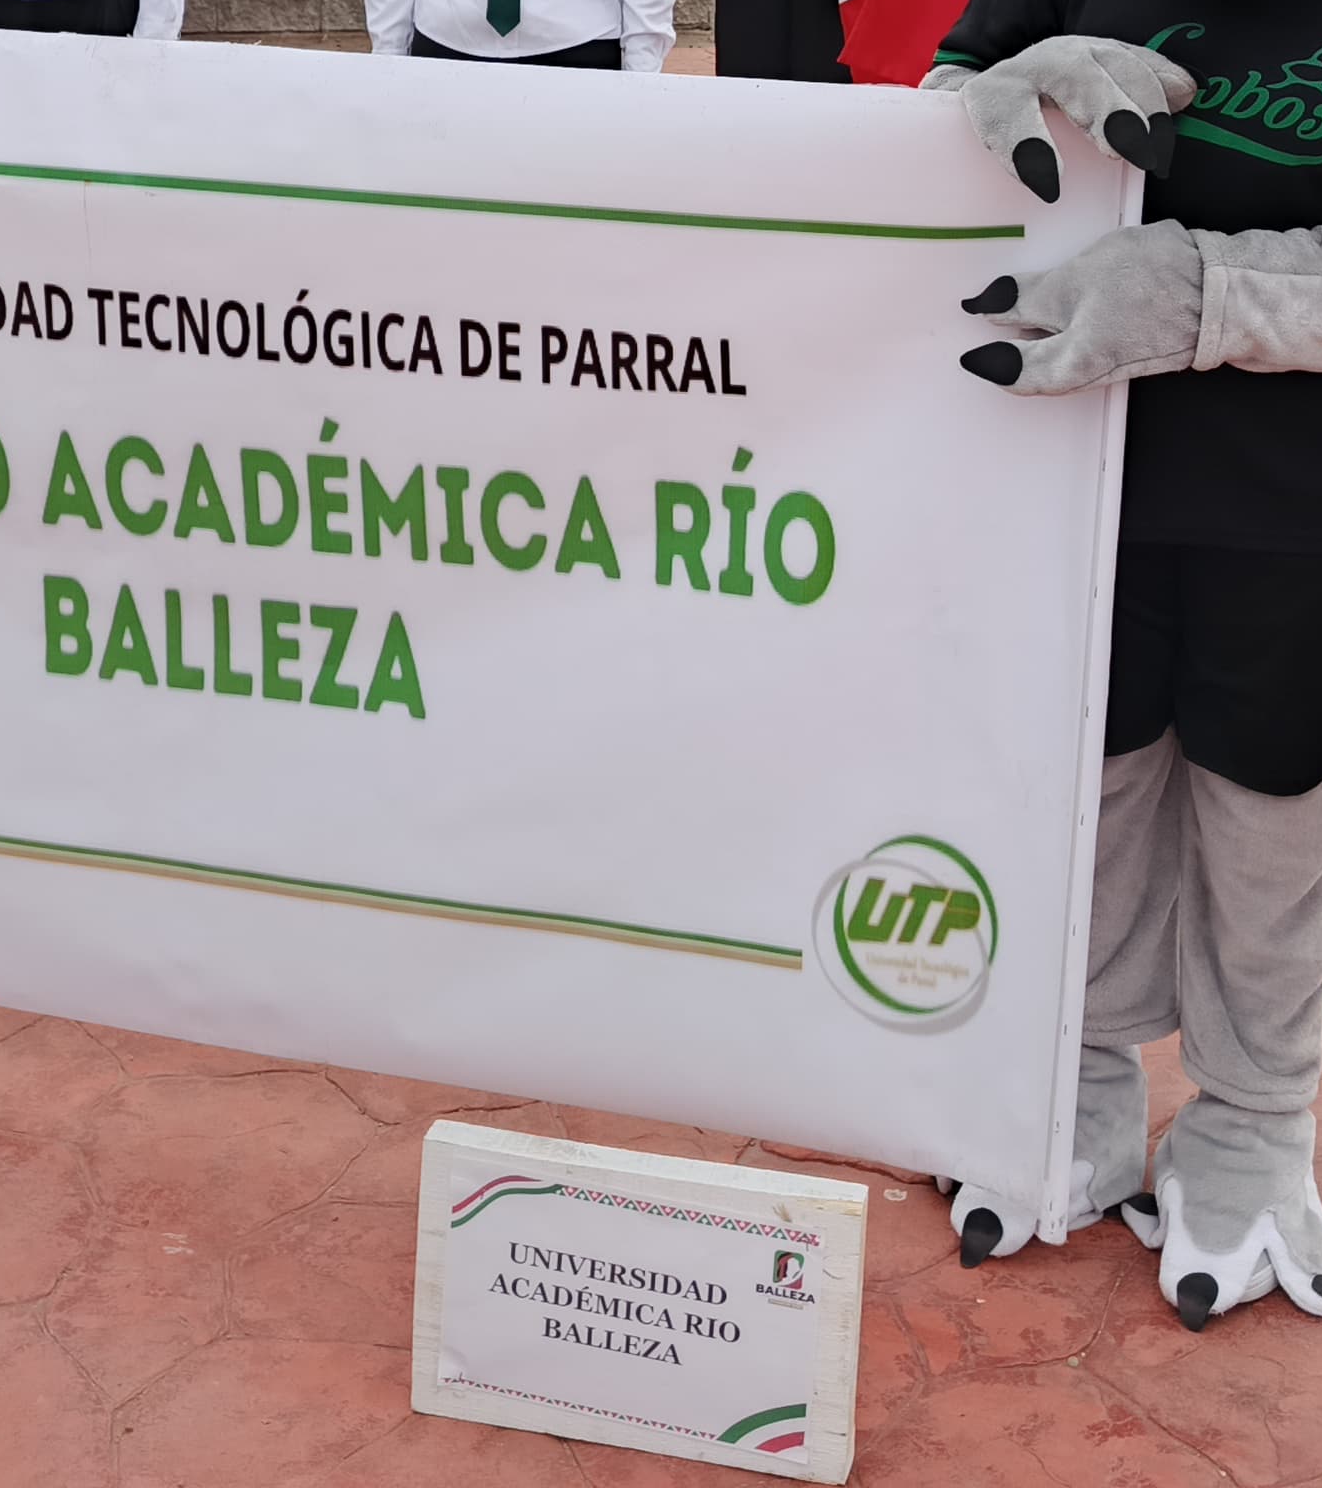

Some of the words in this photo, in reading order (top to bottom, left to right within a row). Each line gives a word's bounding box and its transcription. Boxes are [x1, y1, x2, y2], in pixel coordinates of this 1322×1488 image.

[87, 287, 444, 375] TECNOLÓGICA
[459, 318, 522, 382] DE
[541, 325, 747, 396] PARRAL
[45, 422, 619, 579] ACADÉMICA
[656, 448, 837, 606] RÍO
[44, 576, 425, 720] BALLEZA
[847, 877, 981, 946] UTP
[488, 1272, 675, 1330] ACADÉMICA
[685, 1313, 742, 1344] RIO
[508, 1241, 728, 1306] UNIVERSIDAD
[756, 1284, 816, 1304] BALLEZA
[542, 1316, 682, 1366] BALLEZA
